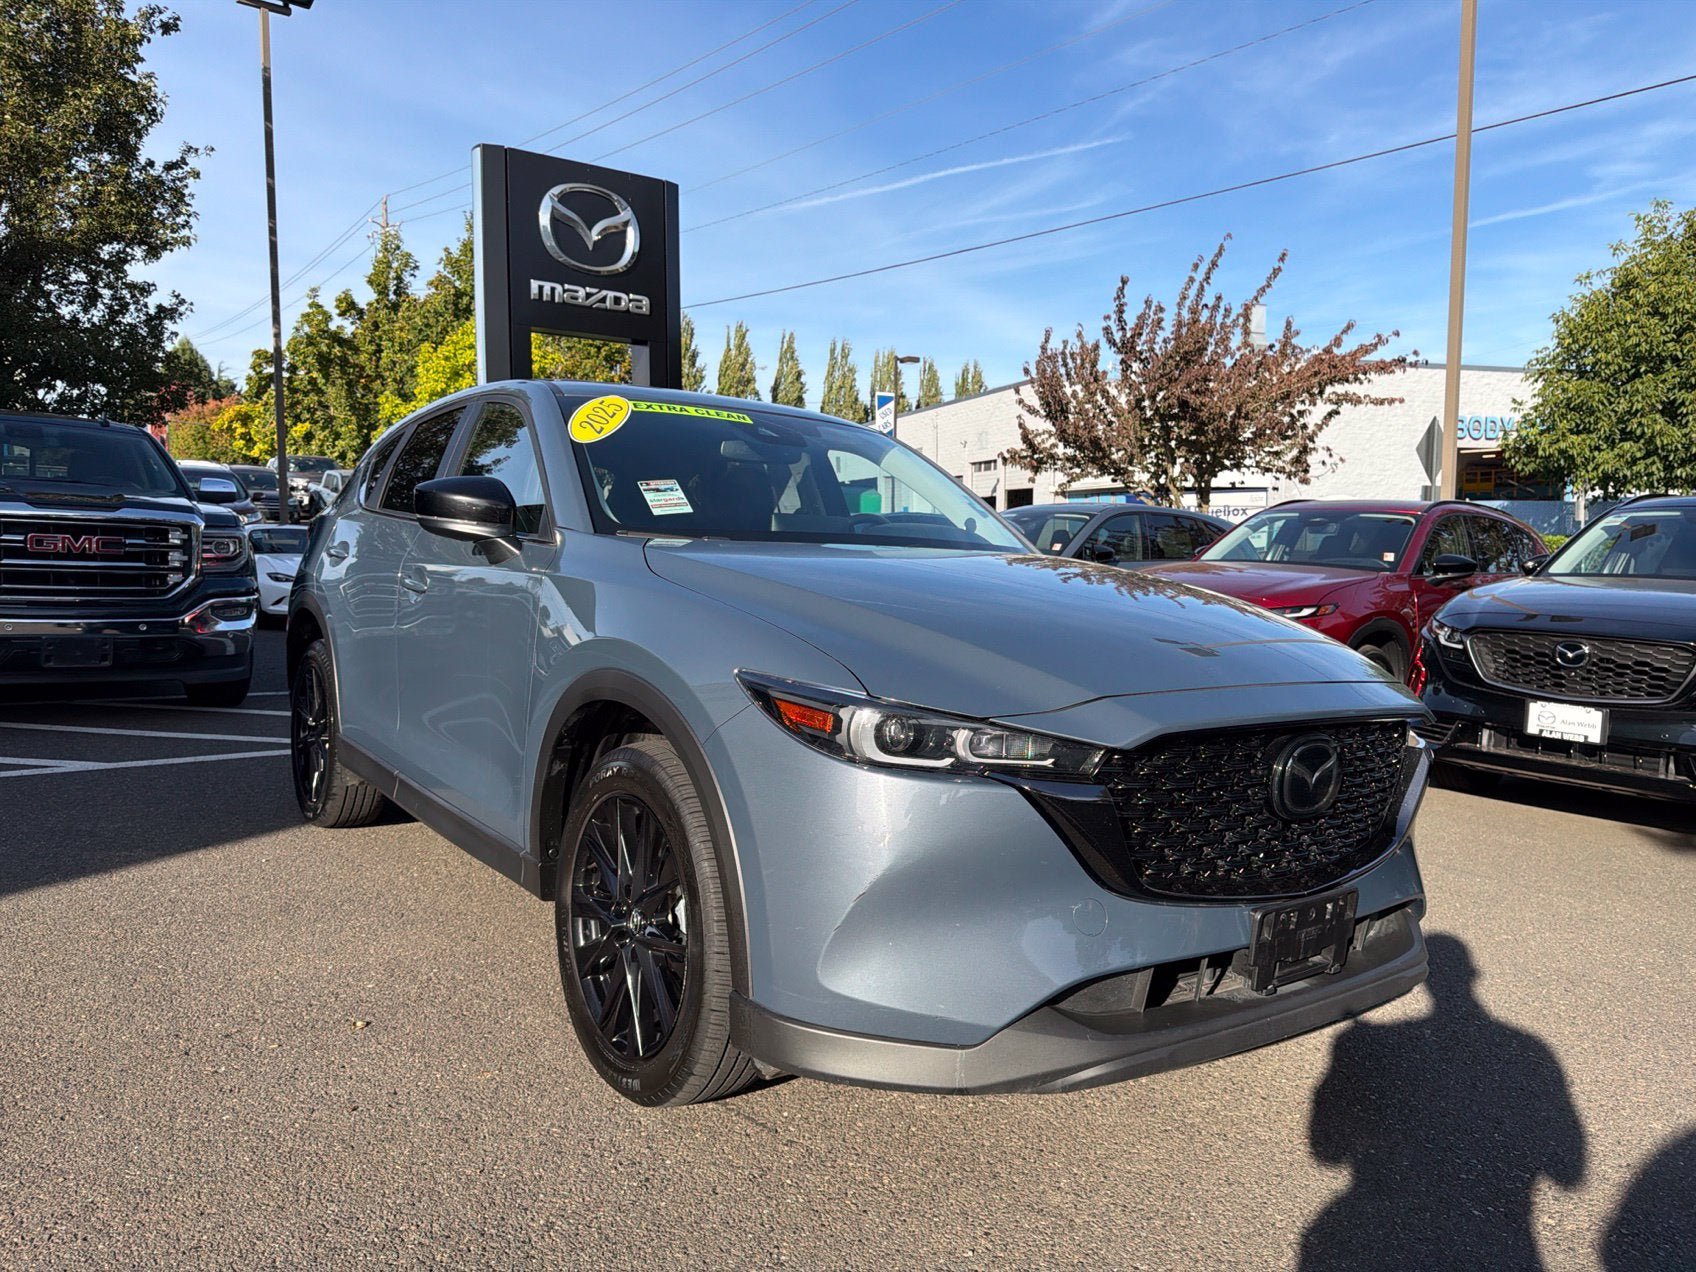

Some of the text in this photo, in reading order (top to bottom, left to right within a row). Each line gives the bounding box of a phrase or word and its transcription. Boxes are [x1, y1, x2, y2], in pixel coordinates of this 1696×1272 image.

[530, 279, 650, 315] mazda
[580, 400, 623, 435] 2025
[632, 402, 747, 421] EXTRA CLEAN
[879, 408, 892, 419] USED
[1457, 416, 1515, 440] BODY
[27, 533, 124, 555] GMC
[1541, 729, 1562, 739] ALAN
[1560, 719, 1576, 727] Alan
[1577, 721, 1597, 729] Webb
